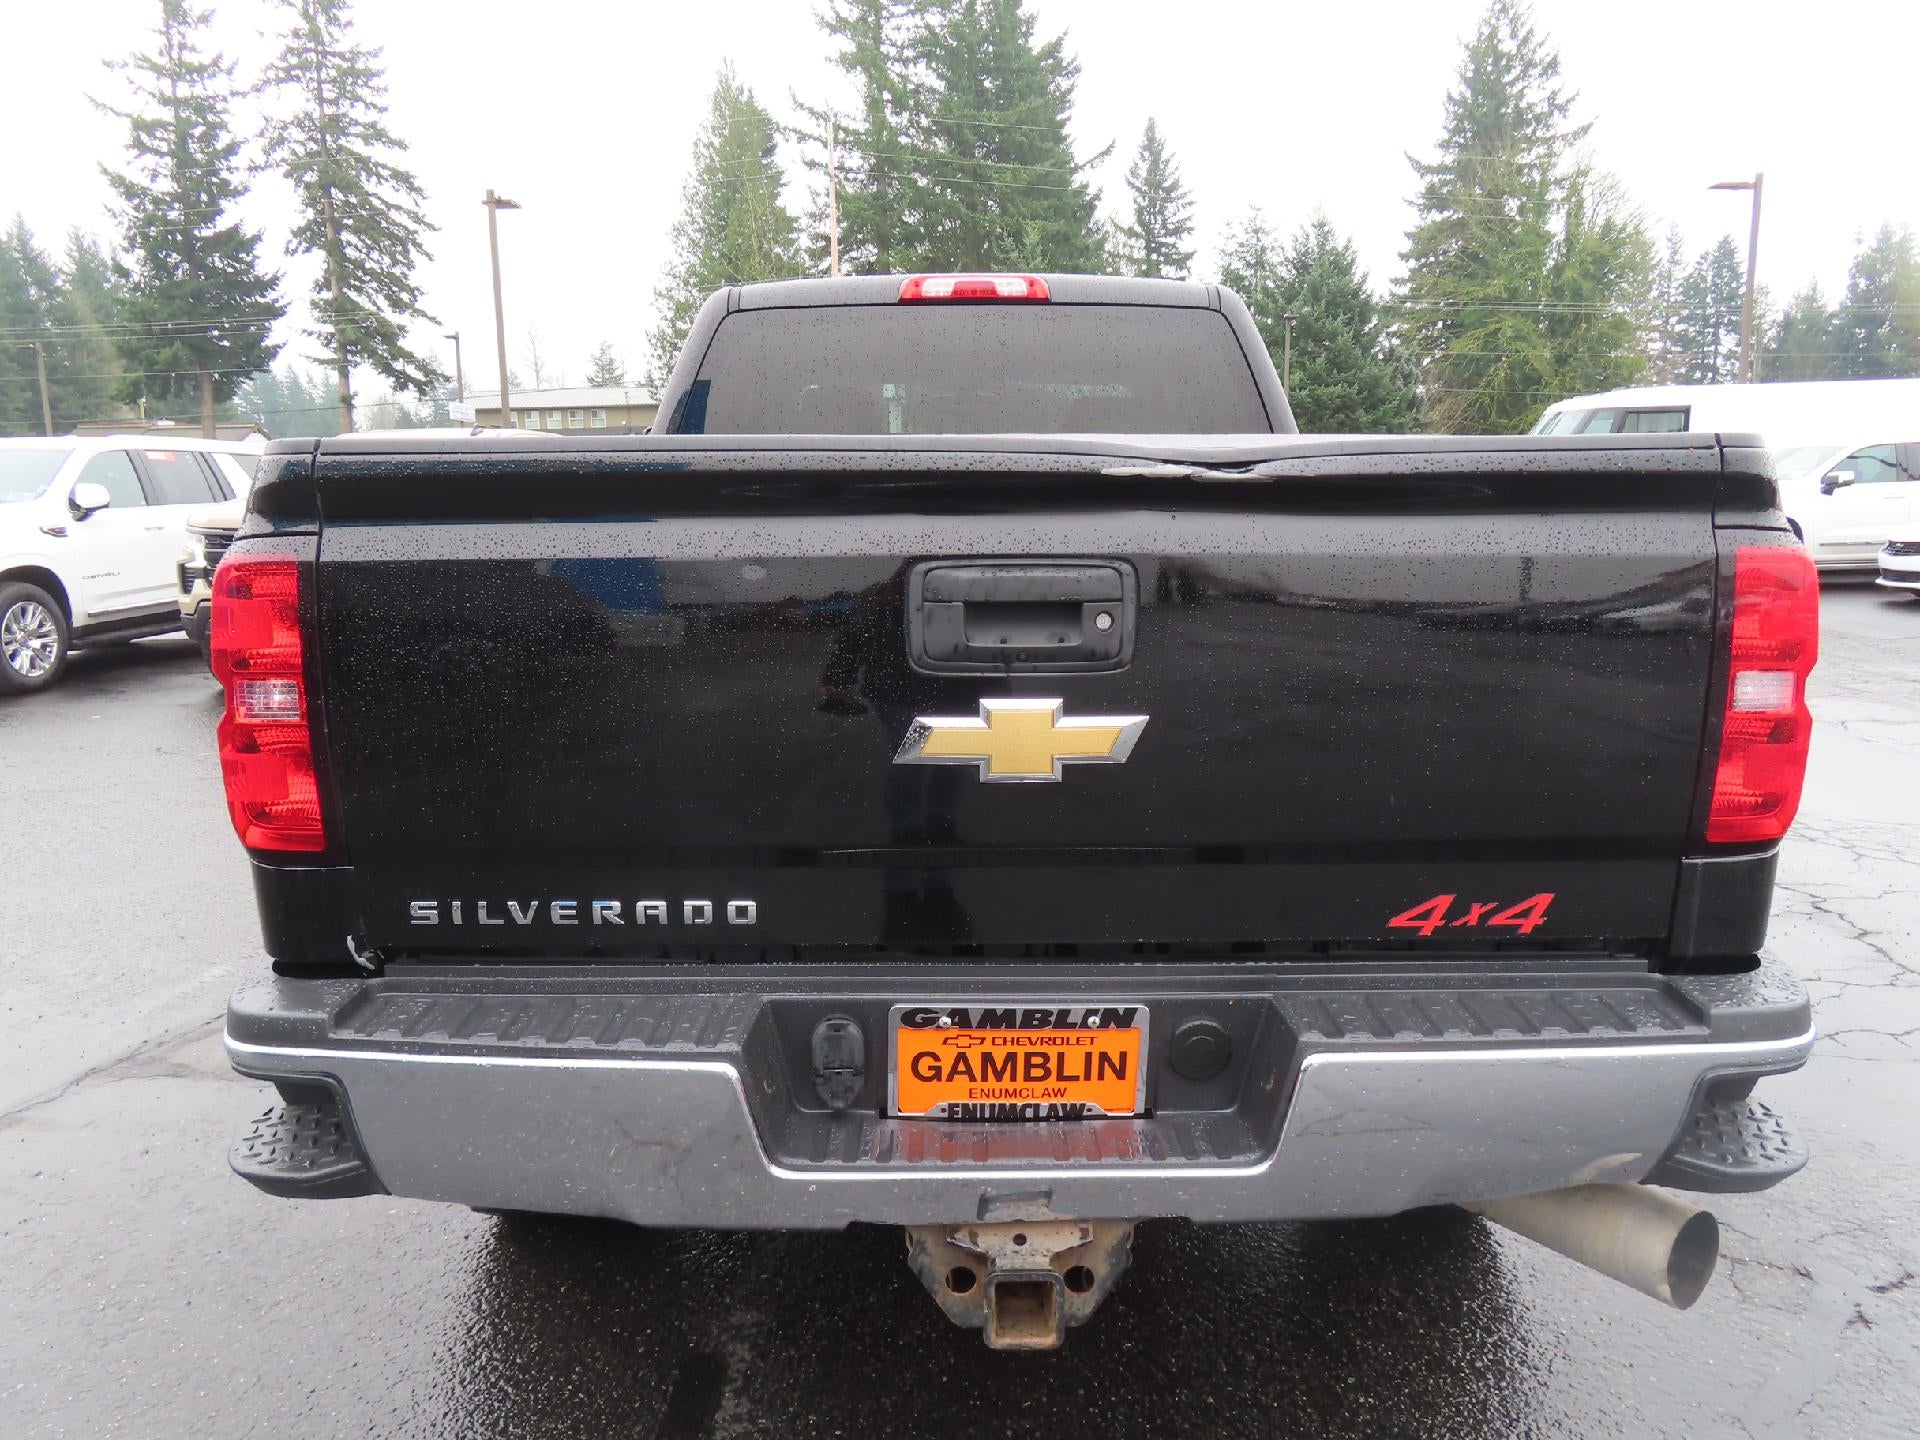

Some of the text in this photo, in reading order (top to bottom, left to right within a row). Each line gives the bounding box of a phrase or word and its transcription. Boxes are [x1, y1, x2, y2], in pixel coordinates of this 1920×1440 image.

[409, 900, 757, 925] SILVERADO
[1387, 893, 1555, 936] 4x4
[900, 1008, 1138, 1029] GAMBLIN
[991, 1036, 1097, 1046] CHEVROLET
[911, 1051, 1127, 1083] GAMBLIN
[969, 1087, 1067, 1099] ENUMCLAW
[948, 1103, 1087, 1121] ENUMCLAW
